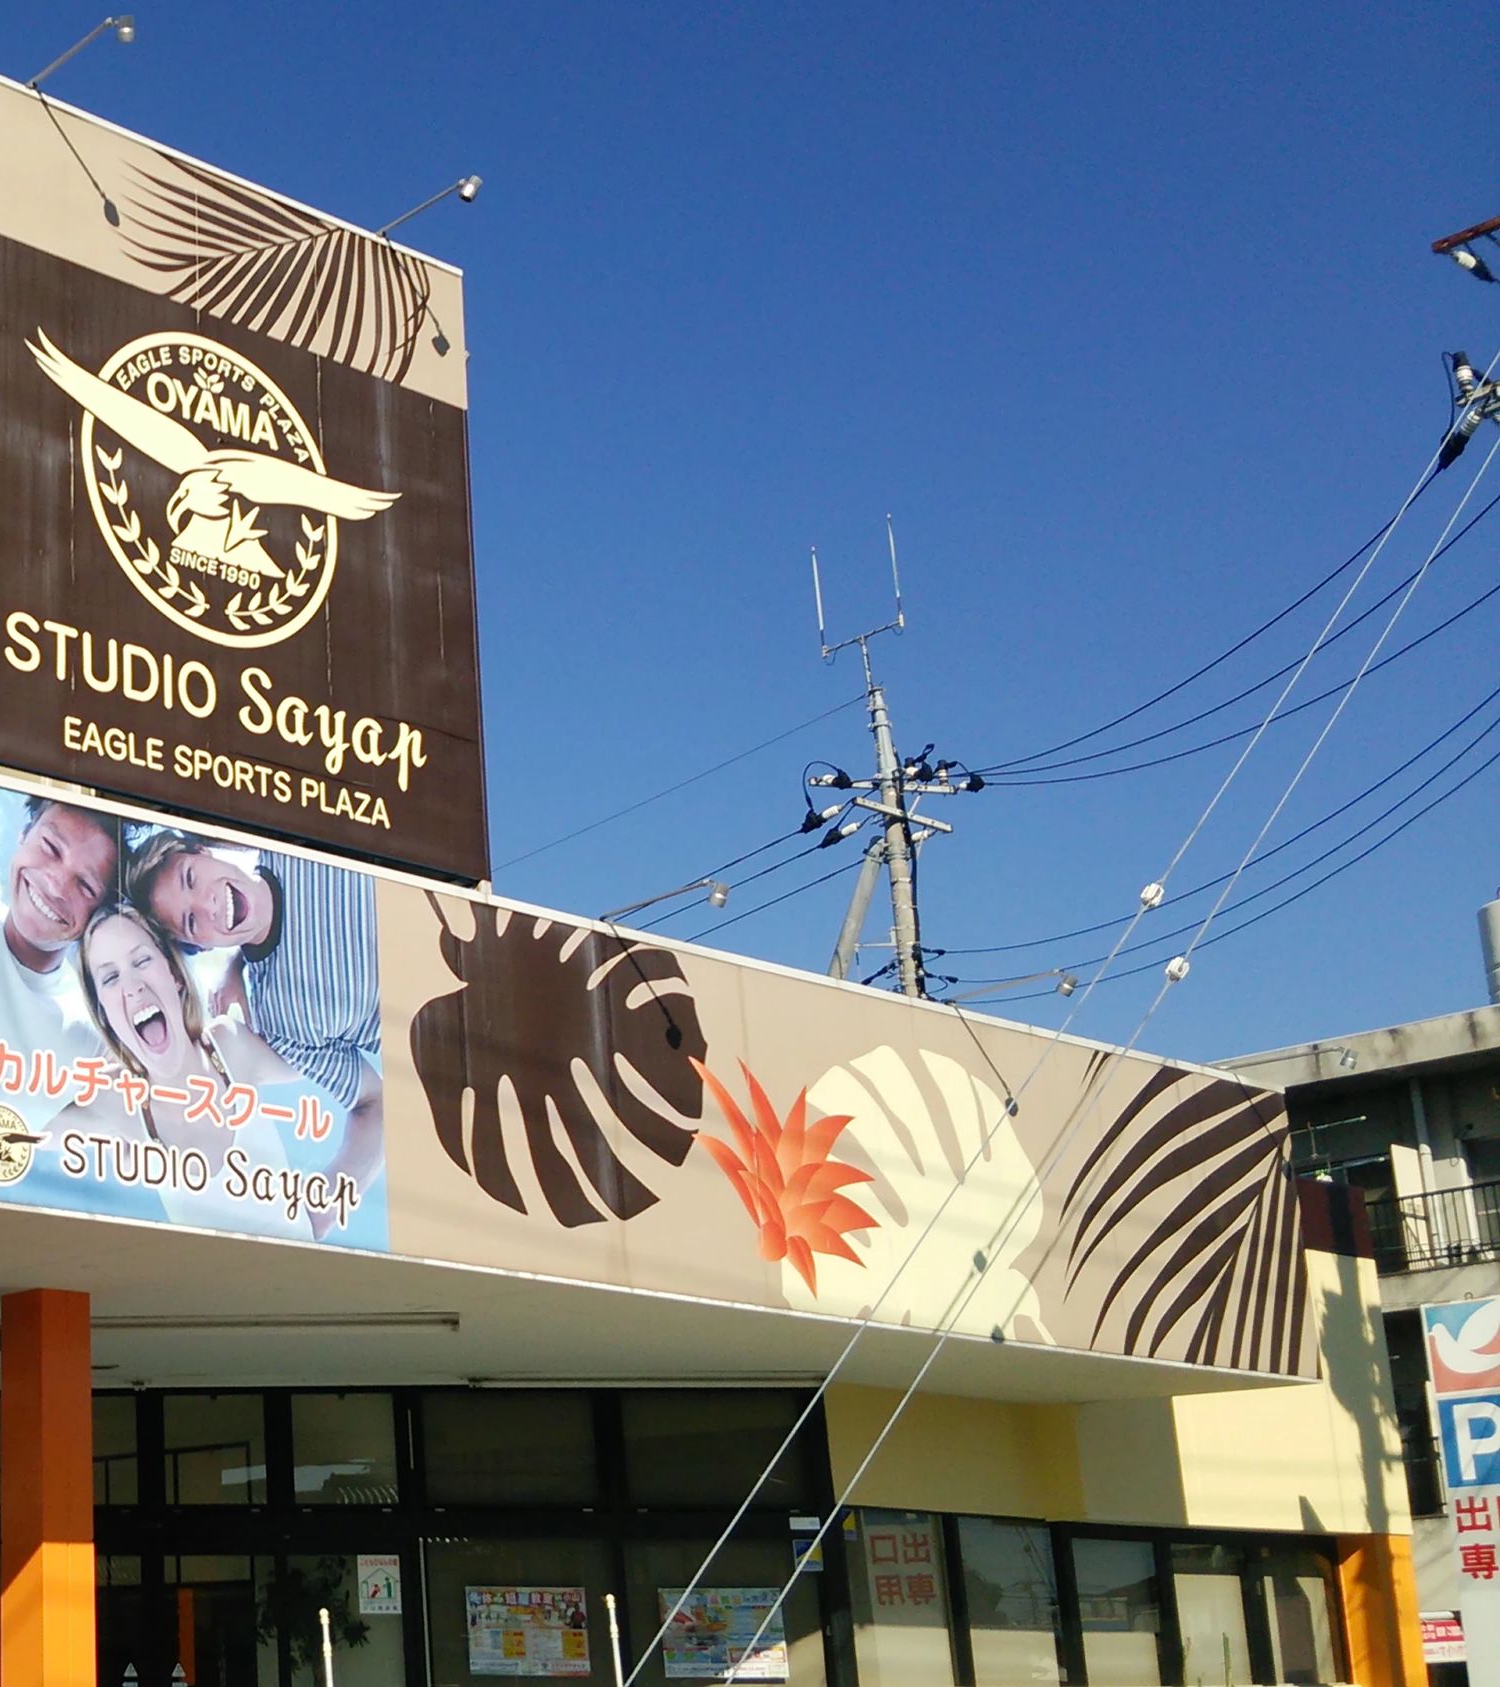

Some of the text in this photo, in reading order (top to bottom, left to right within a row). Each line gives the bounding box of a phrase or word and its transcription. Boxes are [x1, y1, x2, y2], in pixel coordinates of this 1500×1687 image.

[116, 346, 310, 463] EAGLE SPORTS PLAZA
[146, 371, 279, 451] OYAMA
[170, 547, 261, 590] SINCE 1990
[3, 611, 428, 792] STUDIO Sayap
[63, 716, 391, 829] EAGLE SPORTS PLAZA
[64, 1134, 360, 1227] STUDIO Sayap
[1452, 1402, 1500, 1481] P
[1455, 1495, 1500, 1533] 出
